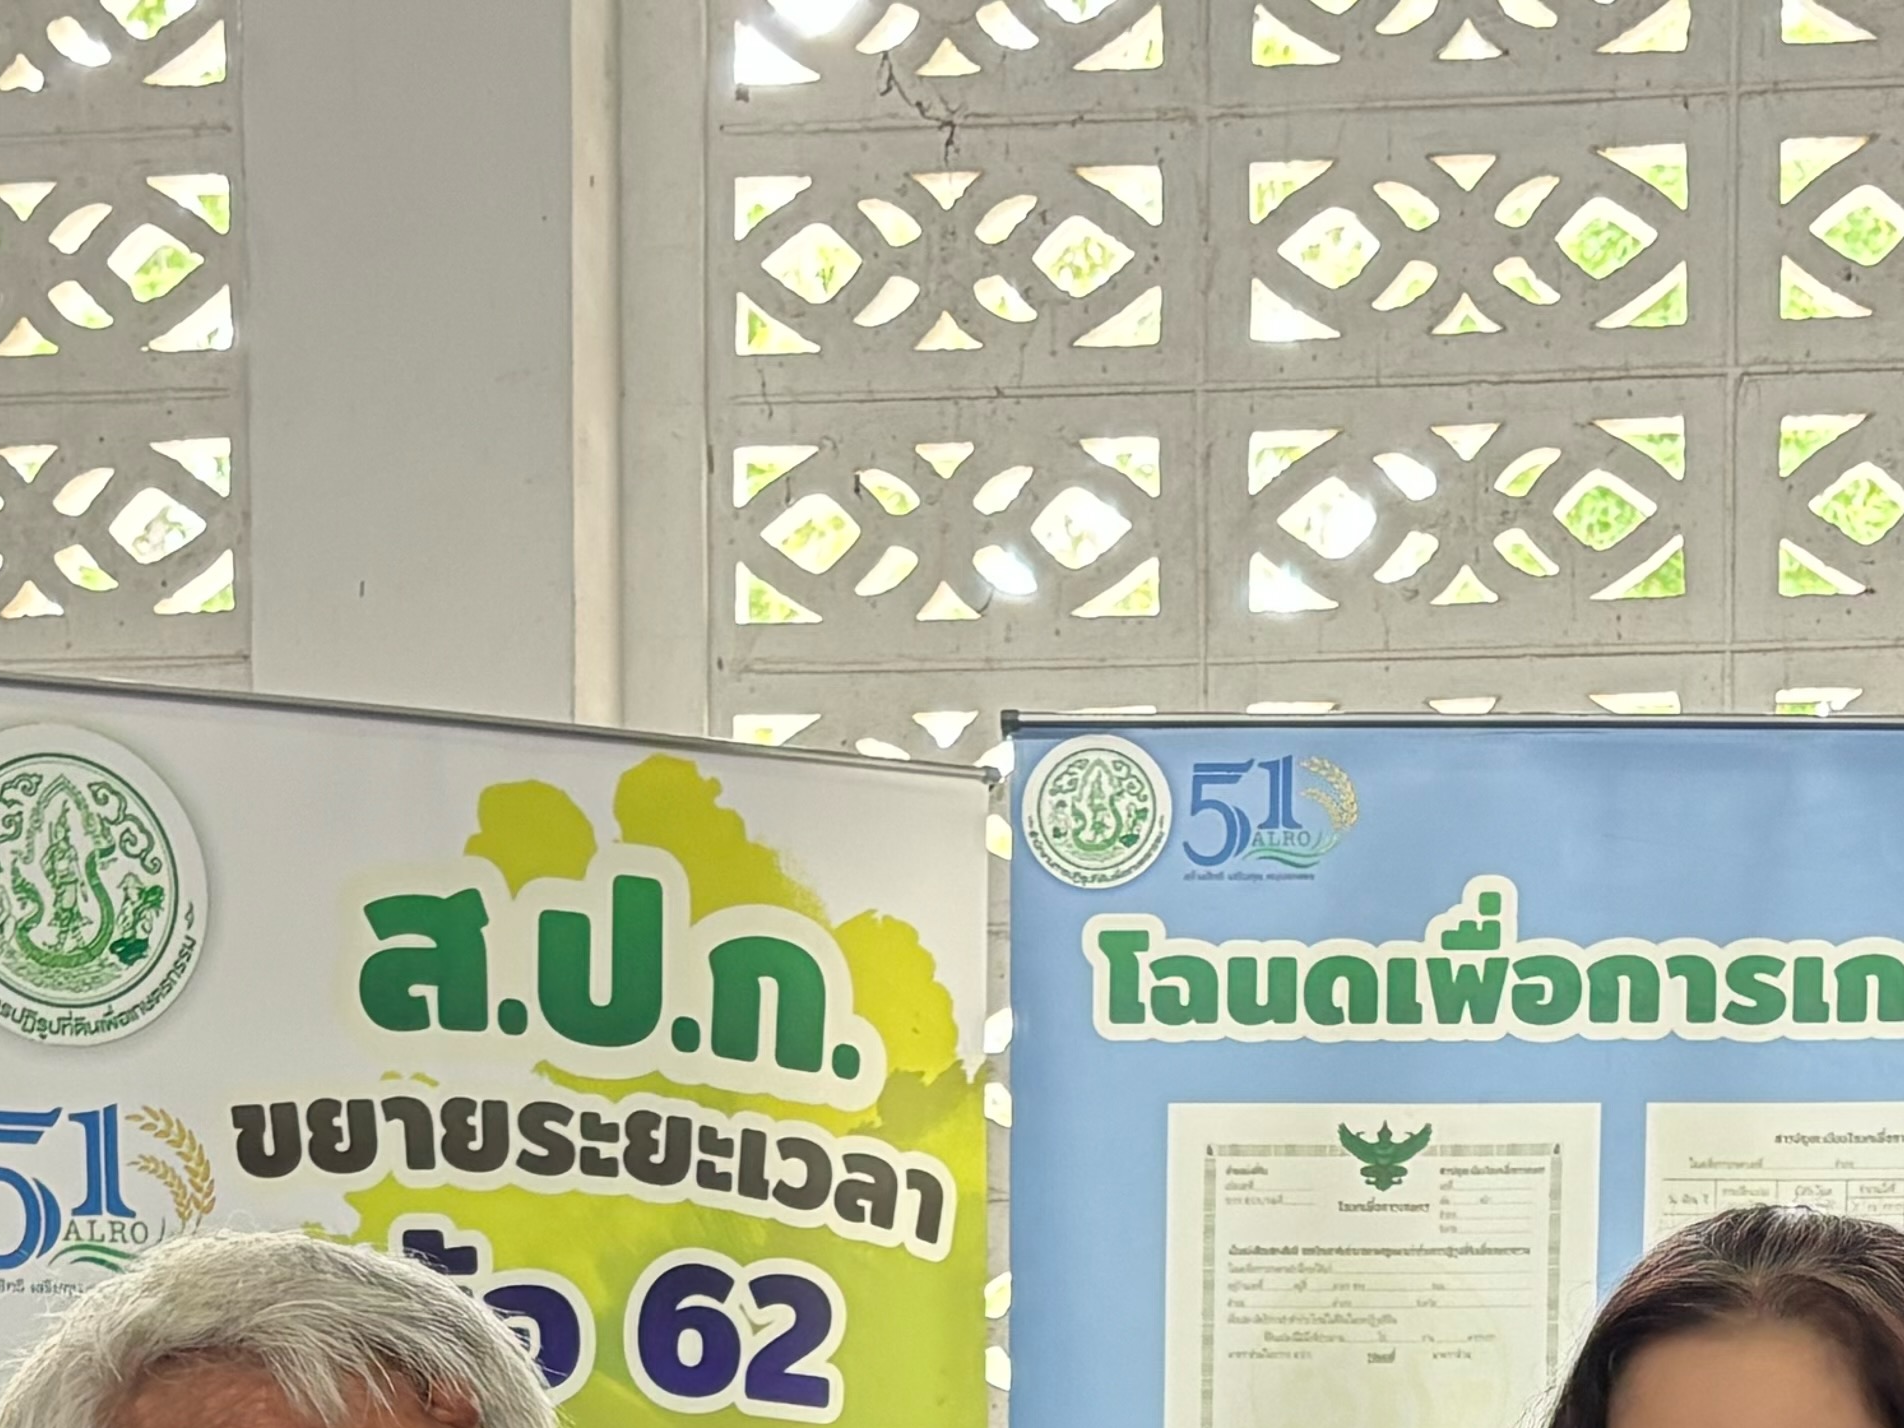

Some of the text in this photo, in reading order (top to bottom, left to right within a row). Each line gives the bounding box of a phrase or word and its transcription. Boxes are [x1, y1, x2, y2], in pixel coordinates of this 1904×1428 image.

[1182, 754, 1303, 867] 51
[1251, 829, 1312, 848] ALRO
[359, 874, 862, 1080] ส.ป.ก.
[62, 1219, 149, 1245] ALRO
[231, 1096, 945, 1245] ขยายระยะเวลา
[637, 1263, 833, 1409] 62
